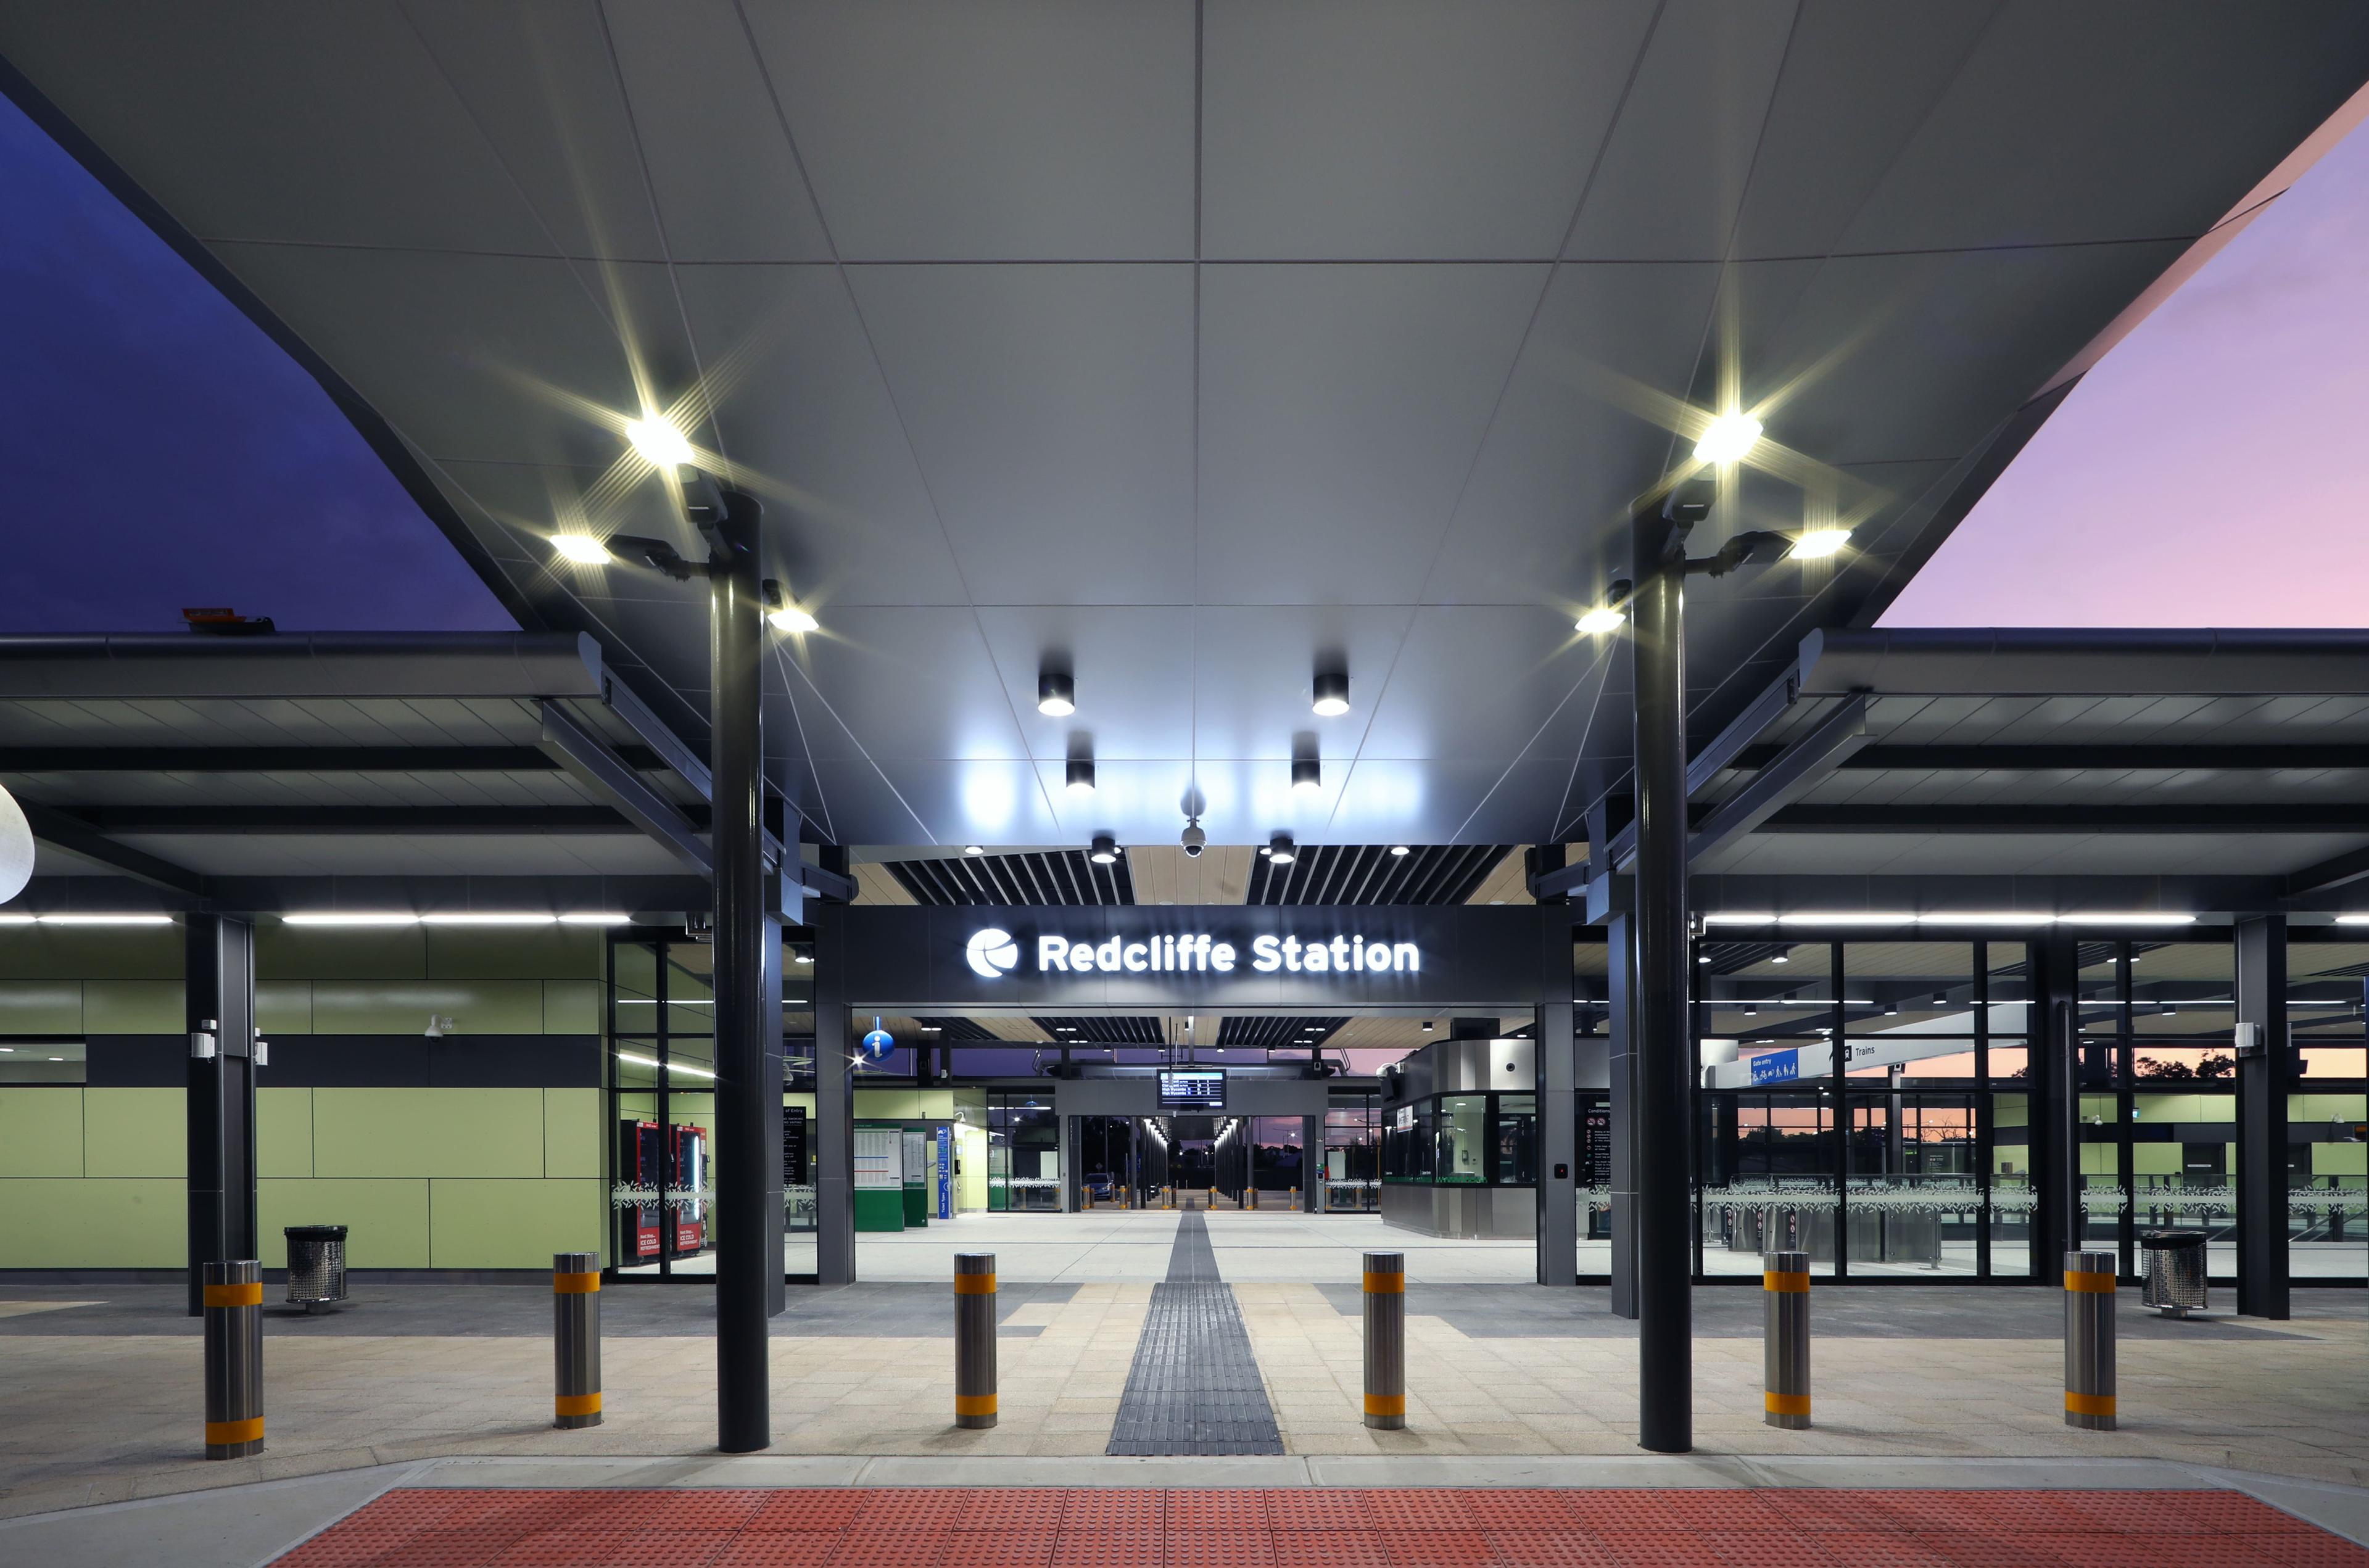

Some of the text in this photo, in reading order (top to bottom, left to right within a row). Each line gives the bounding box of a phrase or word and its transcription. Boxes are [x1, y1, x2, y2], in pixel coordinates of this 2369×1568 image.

[1038, 934, 1420, 973] Redcliffe Station
[1855, 1046, 1875, 1057] Trains
